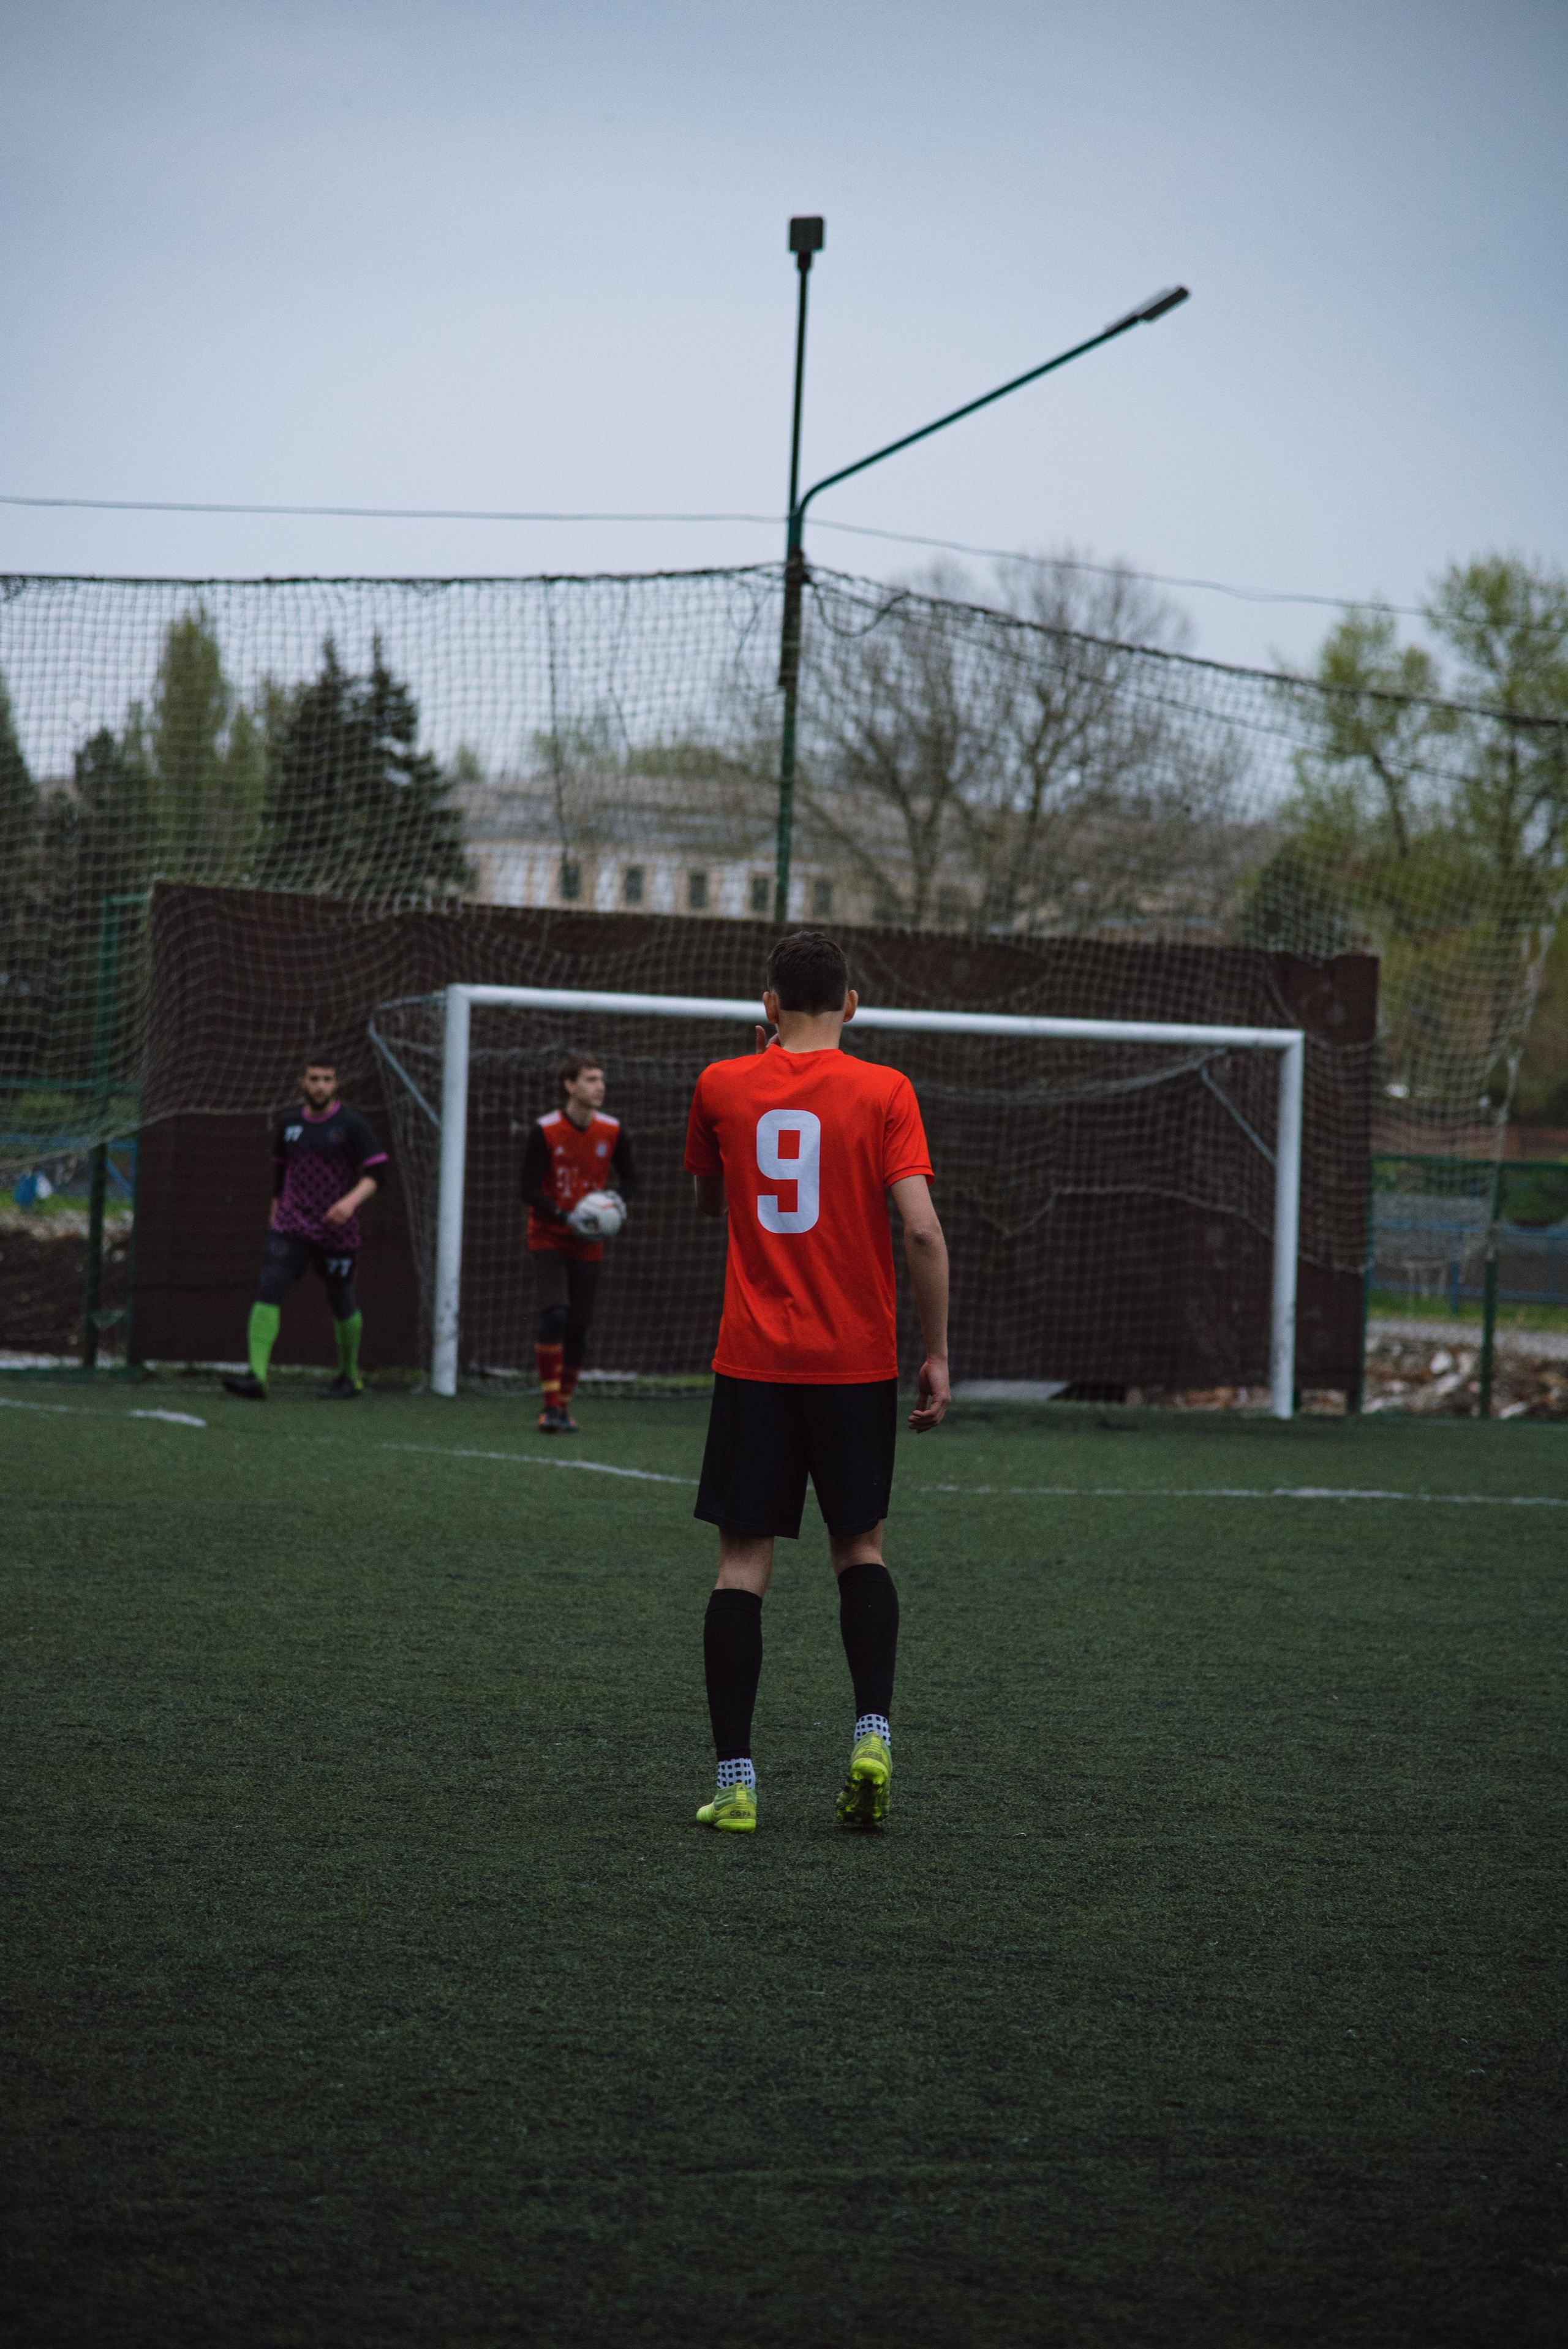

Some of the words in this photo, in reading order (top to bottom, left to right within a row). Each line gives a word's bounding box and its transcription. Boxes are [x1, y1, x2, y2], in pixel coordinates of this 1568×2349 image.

[284, 1124, 303, 1142] 77
[756, 1109, 821, 1233] 9
[327, 1258, 353, 1277] 77
